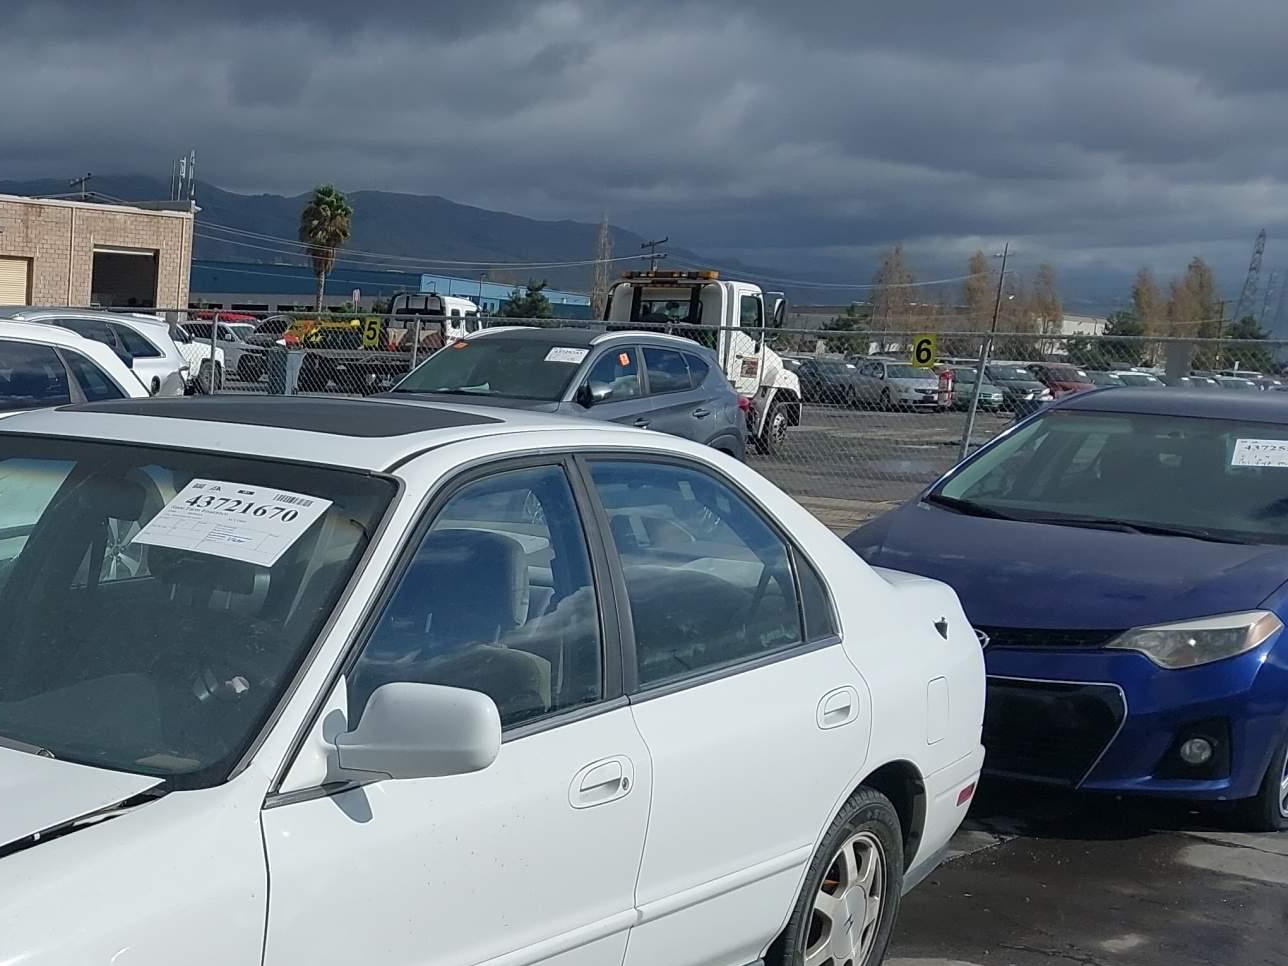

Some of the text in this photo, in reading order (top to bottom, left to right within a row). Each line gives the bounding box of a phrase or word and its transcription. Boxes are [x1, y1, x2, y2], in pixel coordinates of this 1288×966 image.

[366, 320, 378, 341] 5
[915, 338, 932, 364] 6
[184, 494, 300, 523] 43721670
